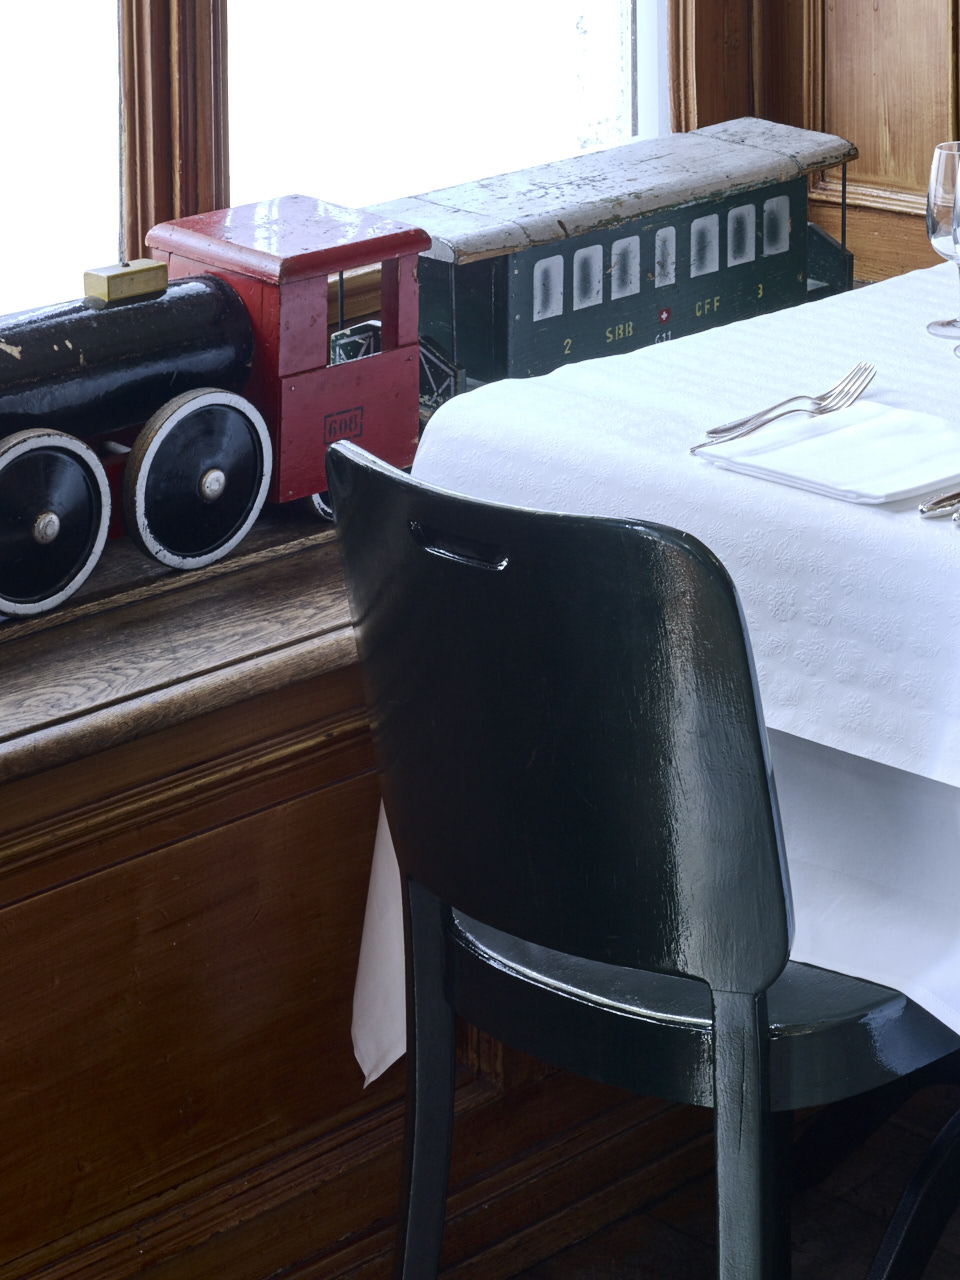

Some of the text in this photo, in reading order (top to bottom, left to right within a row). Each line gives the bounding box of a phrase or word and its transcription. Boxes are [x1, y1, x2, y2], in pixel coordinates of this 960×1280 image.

[563, 283, 764, 355] 2 SBB CFF 3
